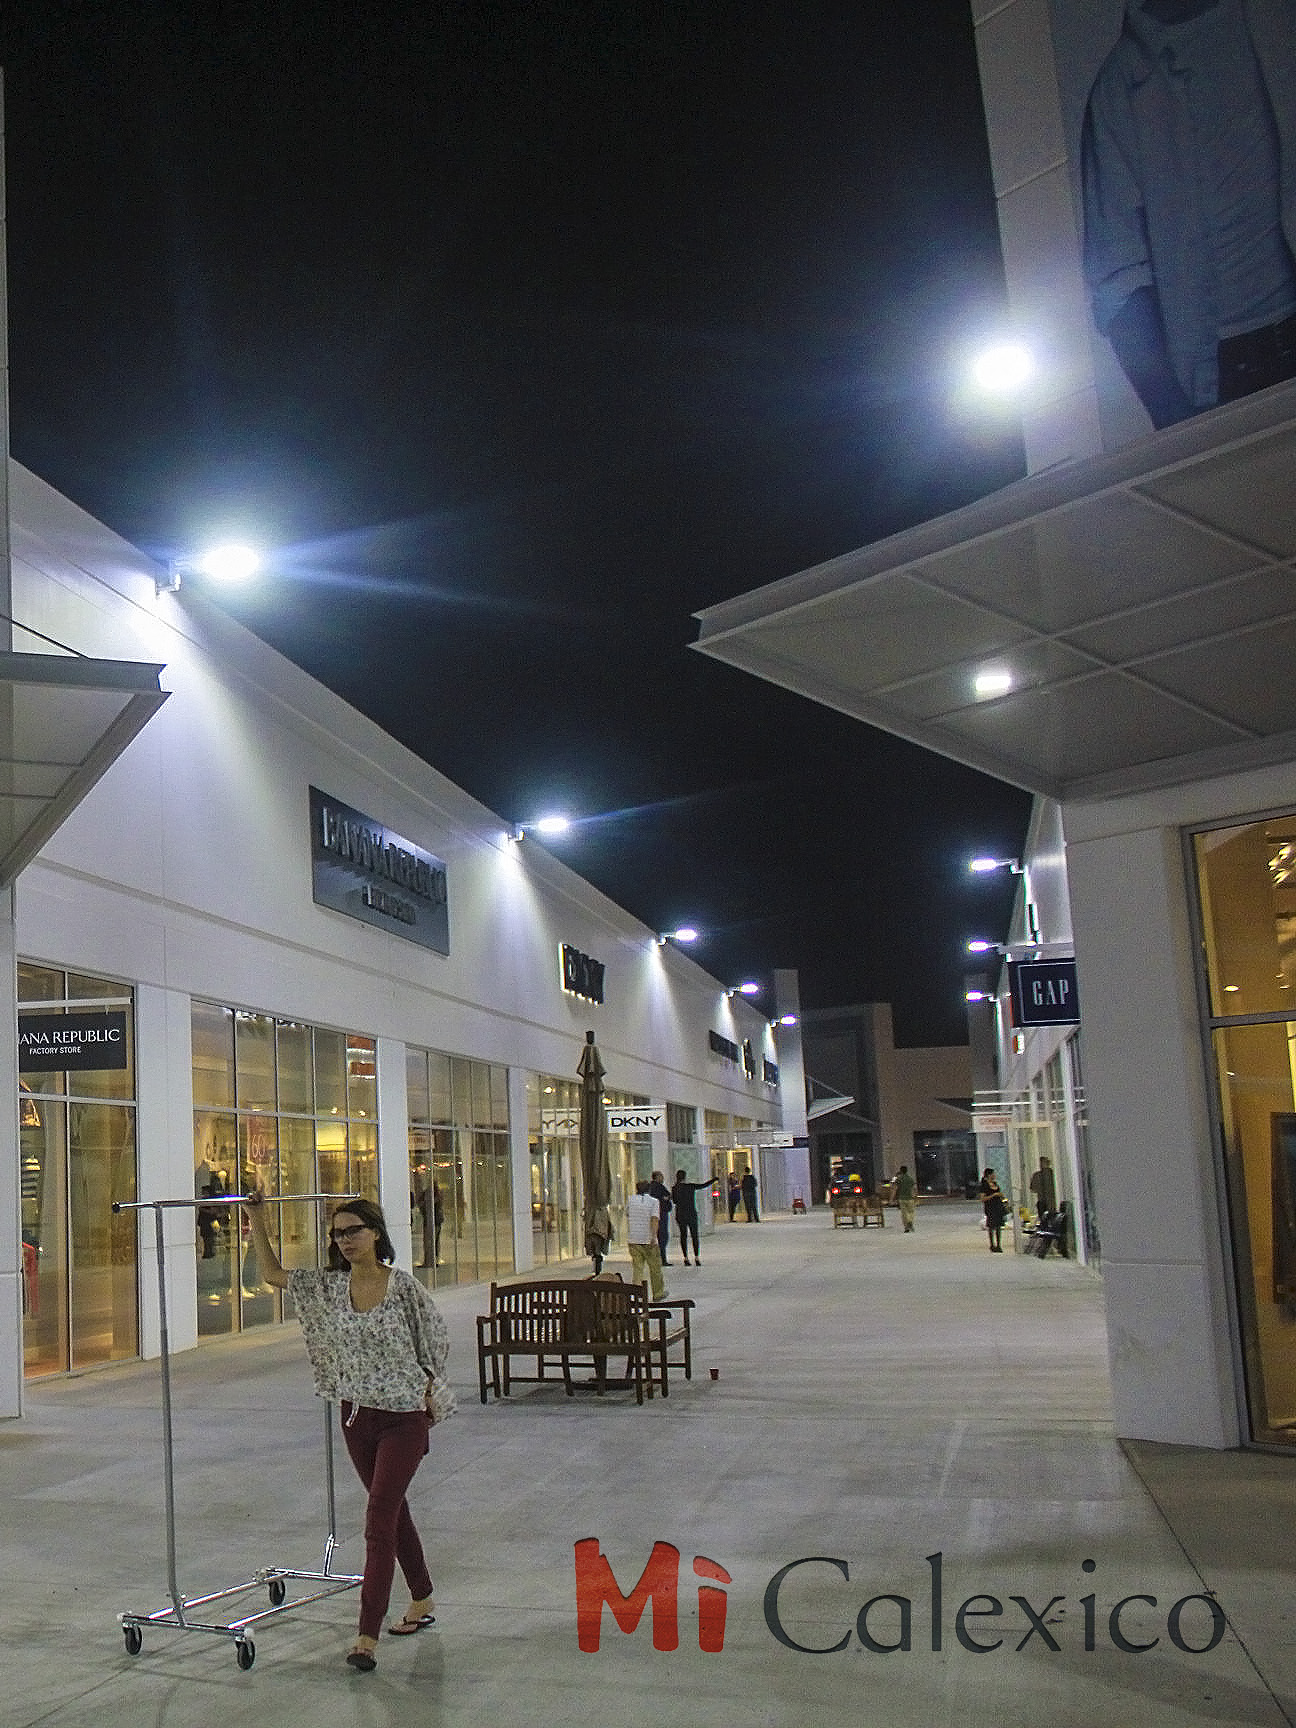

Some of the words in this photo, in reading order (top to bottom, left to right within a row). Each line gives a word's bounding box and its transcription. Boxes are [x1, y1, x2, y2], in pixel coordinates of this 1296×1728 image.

[1032, 979, 1069, 1006] GAP
[18, 1032, 50, 1045] ANA
[52, 1028, 121, 1044] REPUBLIC
[29, 1046, 58, 1055] FACTORY
[59, 1045, 82, 1054] STORE
[611, 1115, 661, 1128] DKNY
